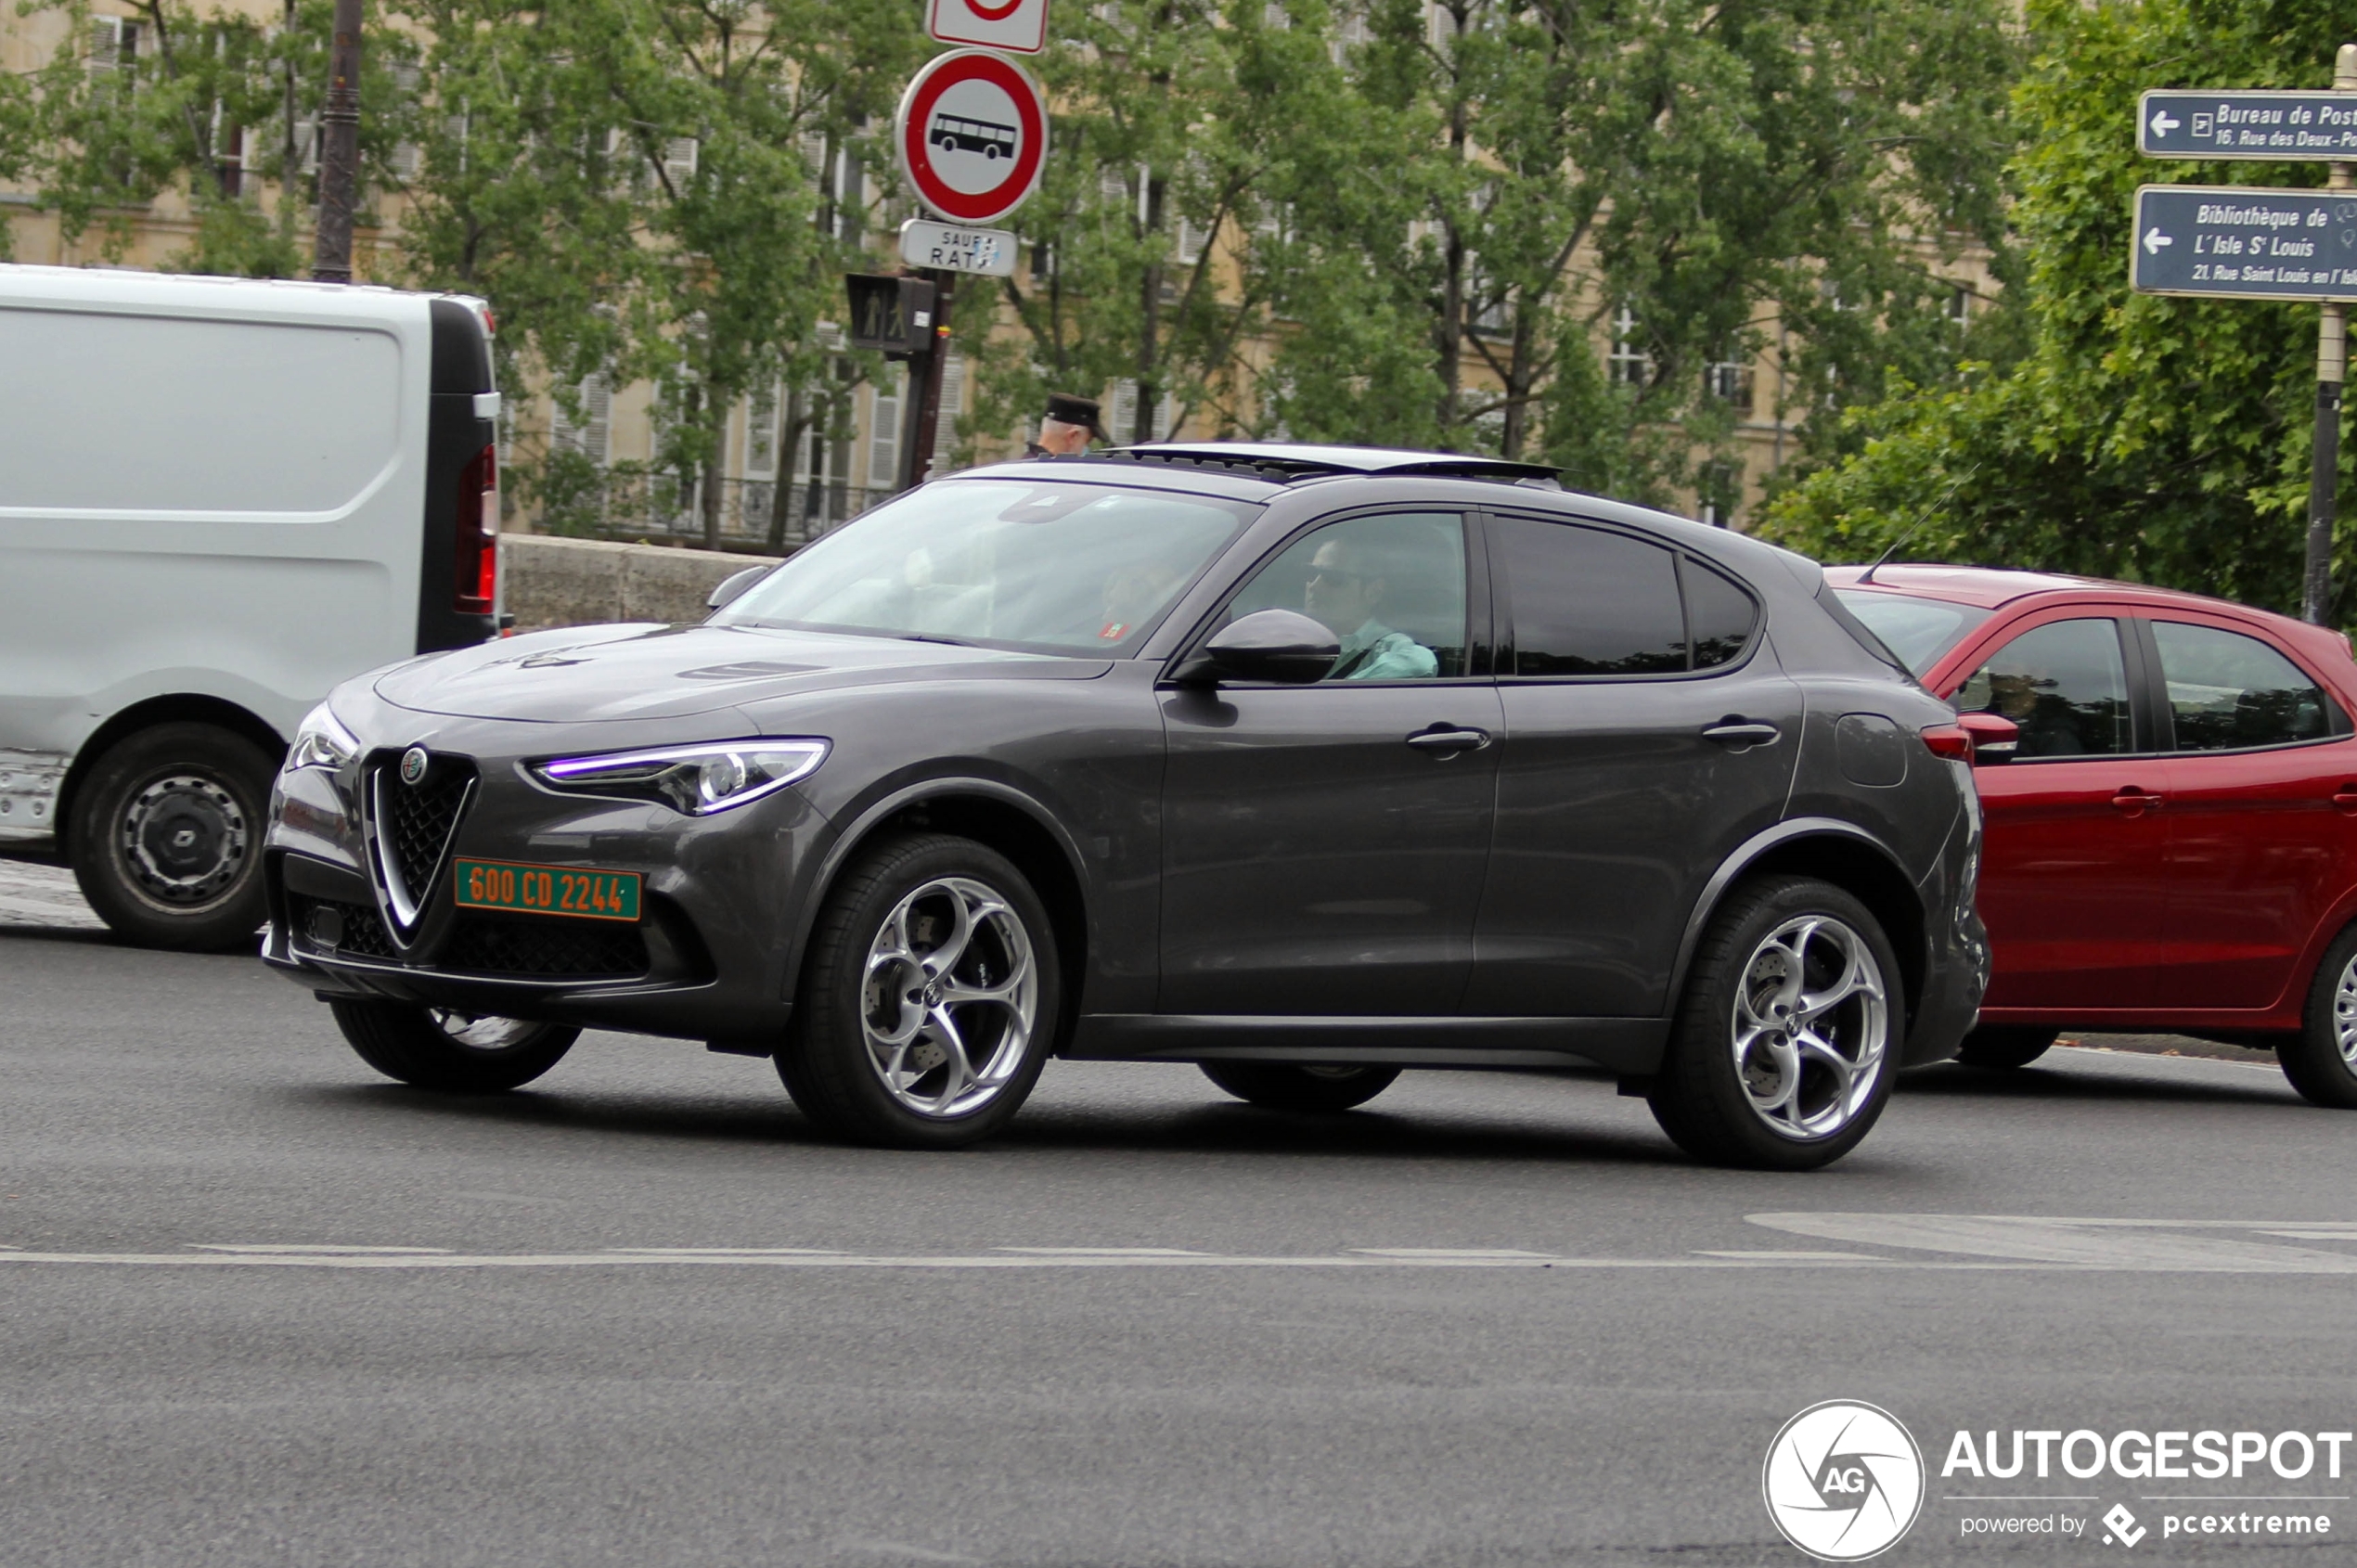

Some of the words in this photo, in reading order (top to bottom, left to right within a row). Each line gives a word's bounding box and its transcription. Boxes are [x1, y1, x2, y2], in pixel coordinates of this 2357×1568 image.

[2216, 104, 2283, 124] Bureau
[2288, 105, 2312, 125] de
[2215, 129, 2236, 146] 16,
[2238, 129, 2267, 147] Rue
[2268, 130, 2295, 148] des
[2196, 204, 2300, 231] Bibliothèque
[2306, 207, 2328, 228] de
[942, 232, 981, 248] SAUF
[2270, 237, 2315, 258] Louis
[2212, 264, 2239, 281] Rue
[2241, 264, 2276, 283] Saint
[2275, 266, 2311, 285] Louis
[2312, 271, 2330, 285] en
[470, 868, 514, 903] 600
[522, 872, 551, 906] CD
[560, 875, 622, 912] 2244
